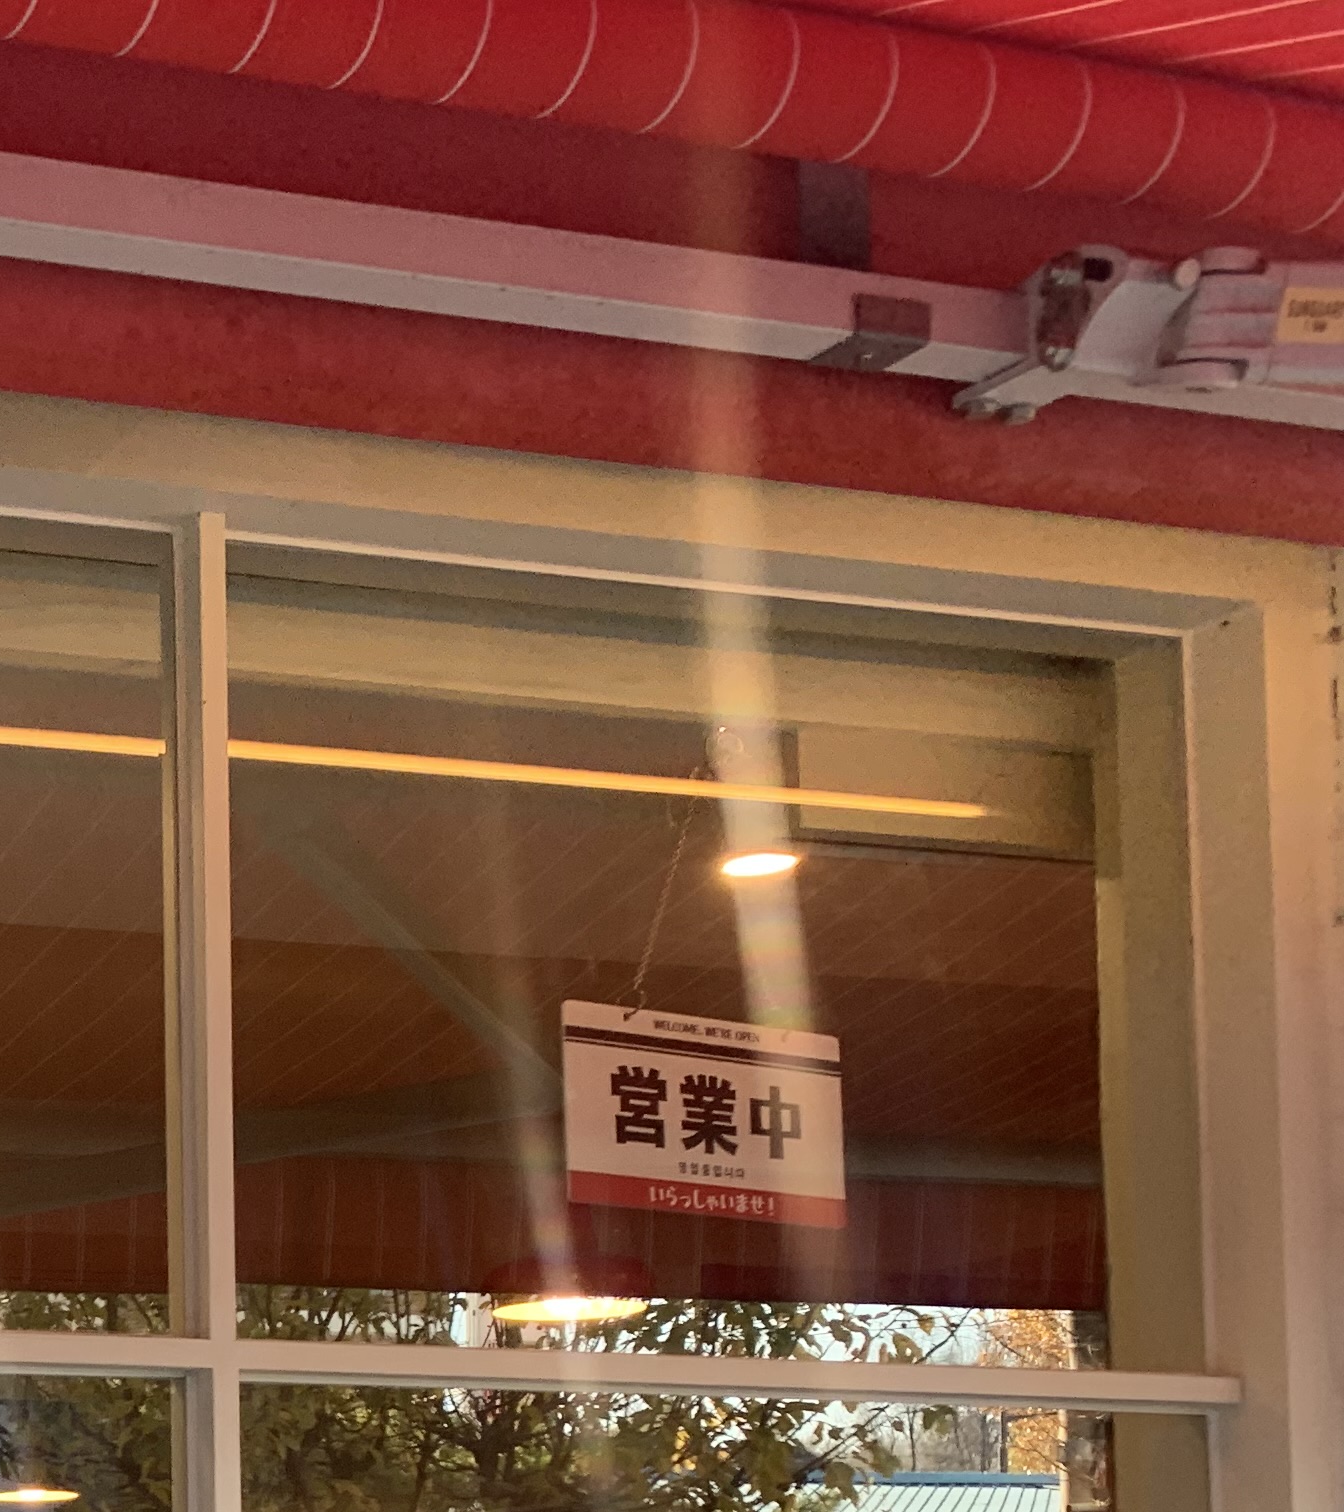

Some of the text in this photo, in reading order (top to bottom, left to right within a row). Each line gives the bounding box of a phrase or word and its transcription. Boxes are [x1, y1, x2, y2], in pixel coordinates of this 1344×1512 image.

[610, 1065, 802, 1160] 営業中
[648, 1185, 775, 1217] いらっしゃいませ!
